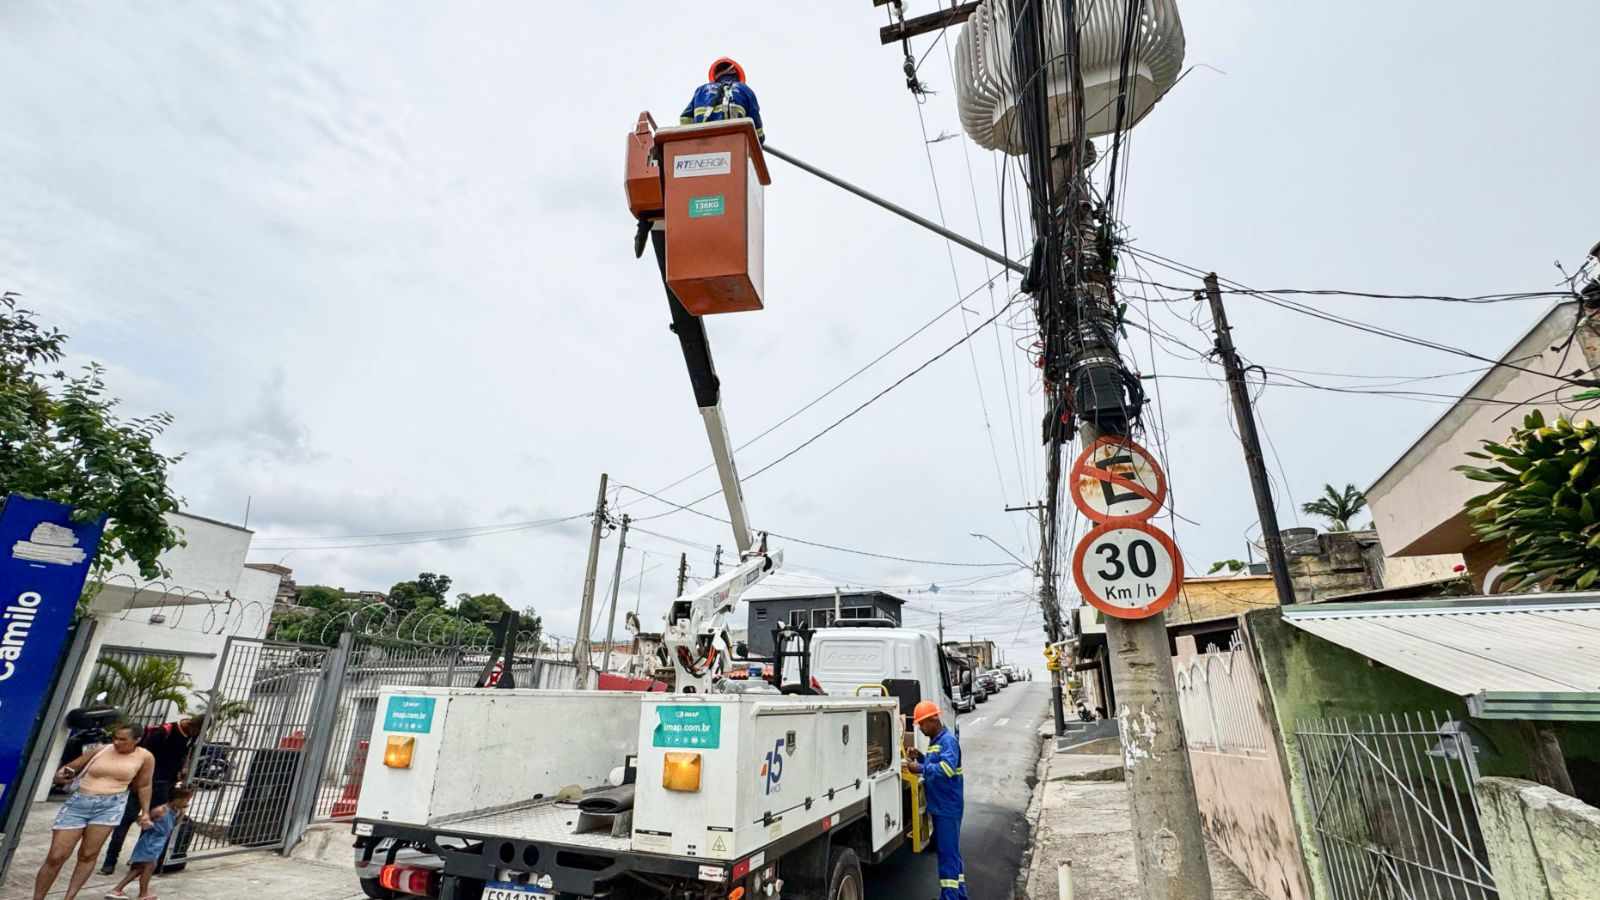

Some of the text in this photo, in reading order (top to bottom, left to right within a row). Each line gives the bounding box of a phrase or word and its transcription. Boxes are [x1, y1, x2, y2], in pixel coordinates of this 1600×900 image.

[1095, 455, 1145, 506] E
[1095, 539, 1157, 581] 30
[765, 738, 785, 795] 15
